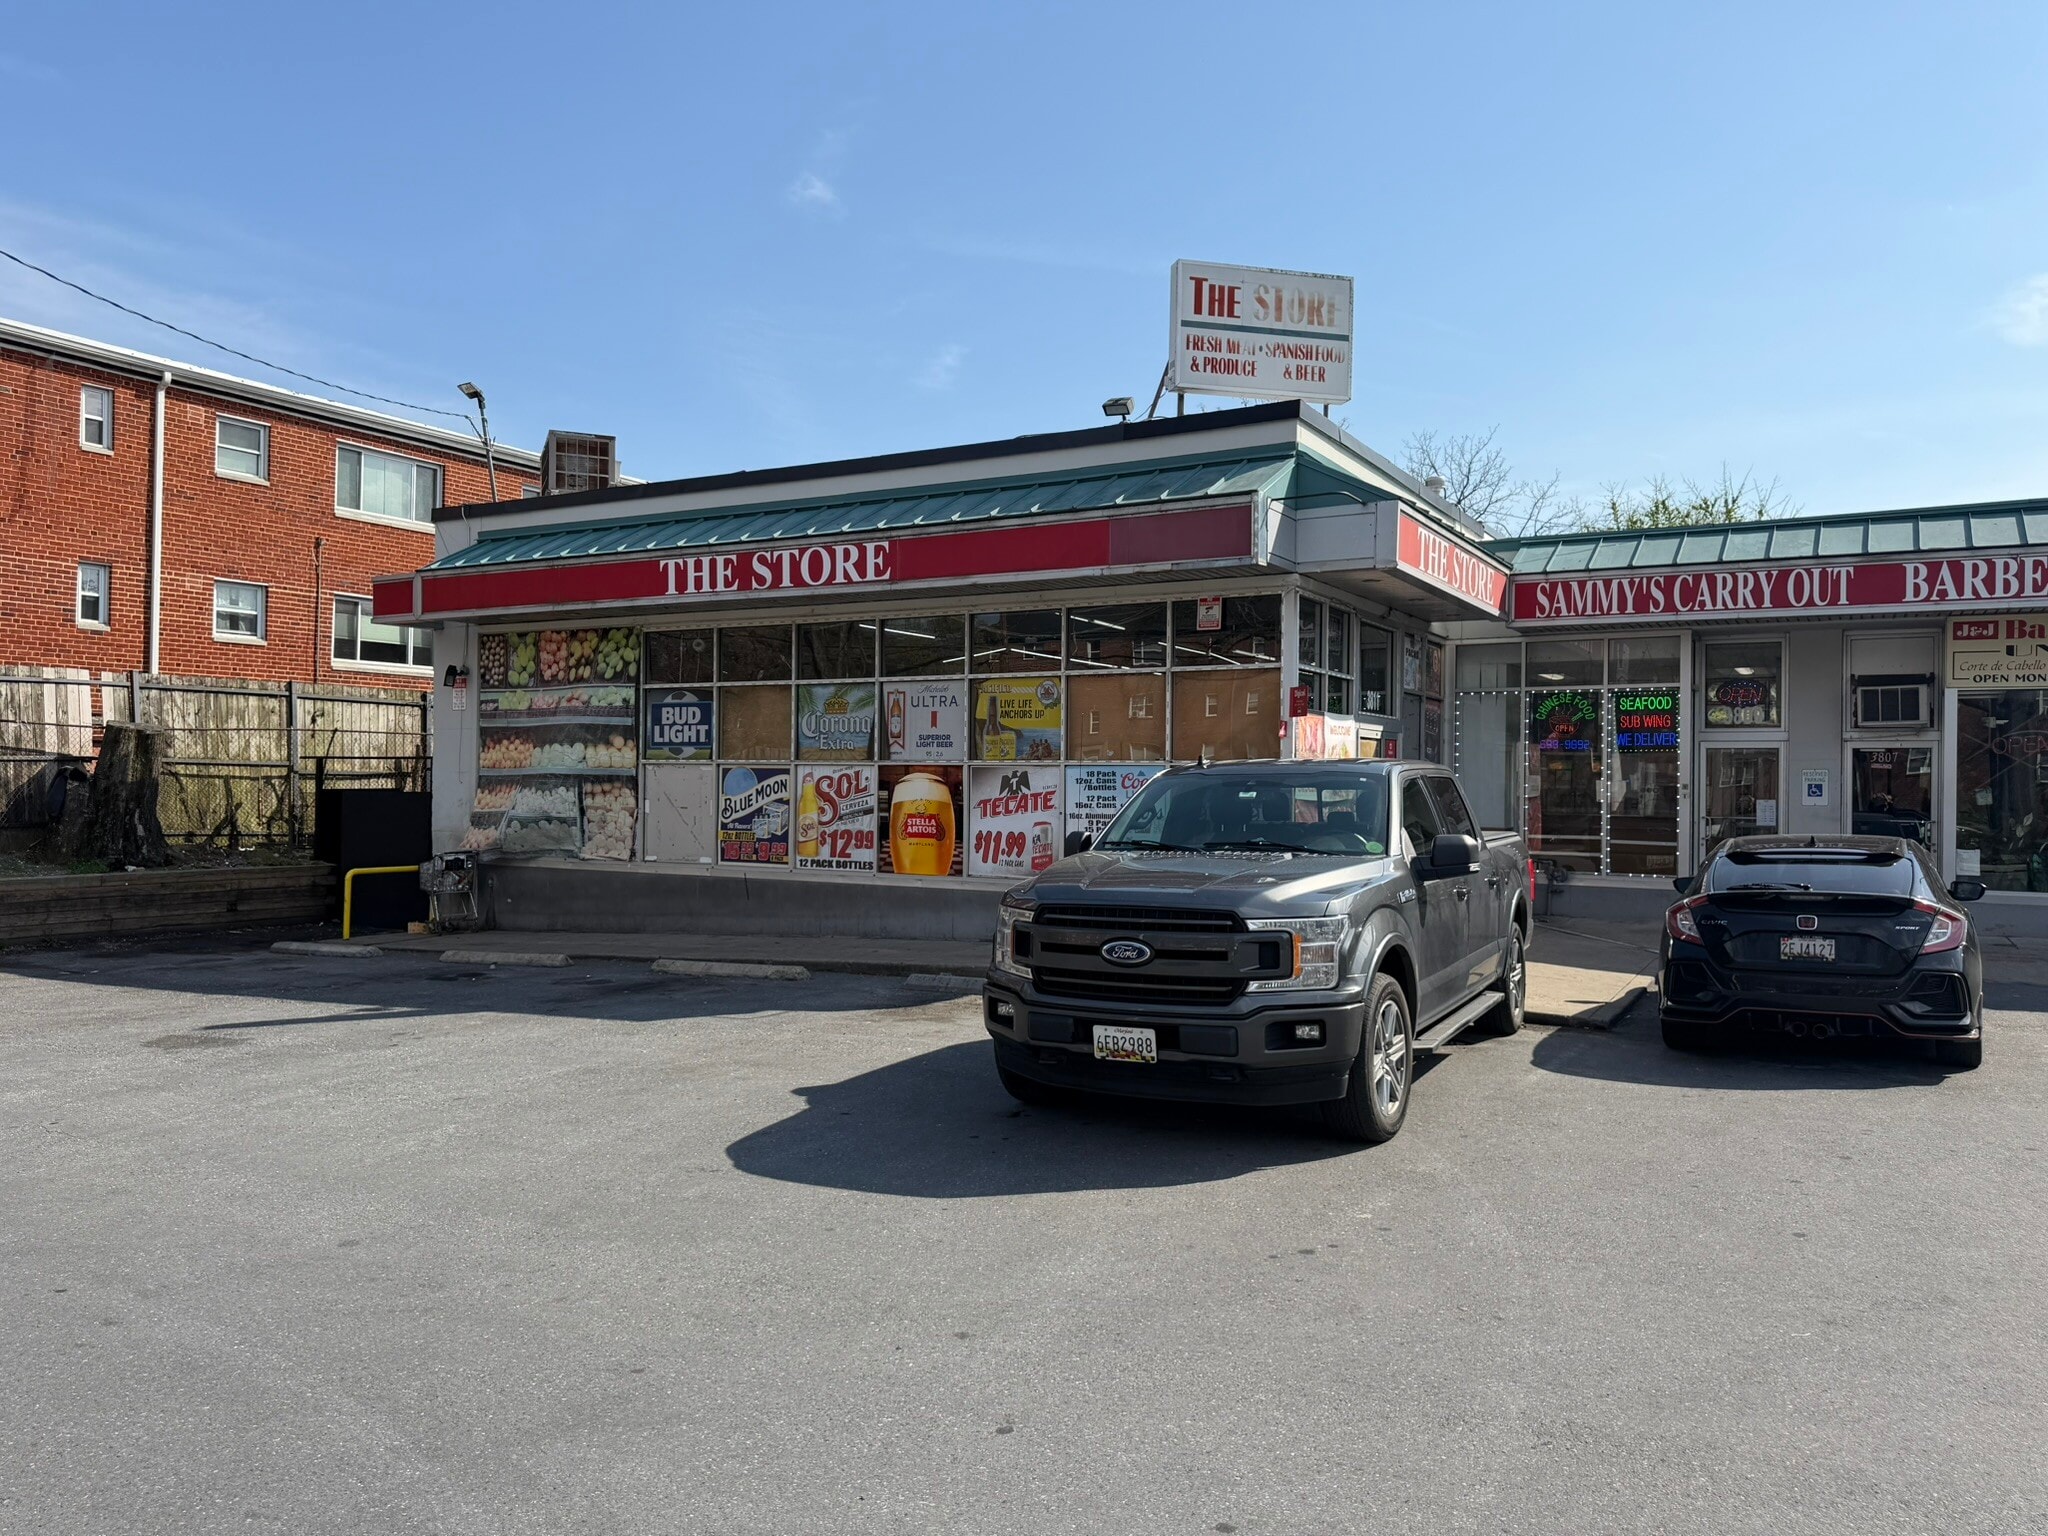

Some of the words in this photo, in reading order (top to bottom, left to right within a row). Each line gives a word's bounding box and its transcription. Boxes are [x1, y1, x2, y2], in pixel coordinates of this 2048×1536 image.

[1189, 276, 1242, 319] THE
[1186, 334, 1222, 353] FRESH
[1265, 341, 1313, 361] SPANISH
[1315, 346, 1345, 364] FOOD
[1190, 356, 1200, 372] &
[1203, 359, 1257, 377] PRODUCE
[1283, 364, 1292, 380] &
[1296, 364, 1326, 383] BEER
[659, 554, 738, 595] THE
[751, 541, 891, 590] STORE
[1417, 526, 1449, 582] THE
[1452, 548, 1495, 605] STORE
[1902, 556, 2048, 601] BARBE
[1535, 575, 1665, 619] SAMMY'S
[1673, 570, 1779, 611] CARRY
[1787, 566, 1854, 606] OUT
[1956, 623, 1994, 637] J&J
[1960, 661, 1988, 672] Corte
[1991, 660, 2003, 671] de
[2006, 659, 2046, 671] Cabello
[1973, 673, 2009, 683] OPEN
[2015, 673, 2047, 682] MON
[911, 695, 959, 708] ULTRA
[1720, 687, 1763, 702] OPEN
[1000, 699, 1015, 708] LIVE
[1018, 699, 1033, 708] LIFE
[1536, 693, 1573, 720] CHINESE
[1573, 695, 1596, 720] FOOD
[1620, 697, 1672, 711] SEAFOOD
[662, 706, 701, 725] BUD
[1000, 709, 1033, 718] ANCHORS
[1035, 709, 1045, 718] UP
[801, 710, 871, 740] Corona
[1555, 724, 1574, 732] OPEN
[1620, 716, 1640, 728] SUB
[1643, 715, 1671, 727] WING
[654, 725, 708, 742] LIGHT
[1617, 733, 1633, 746] WE
[1634, 732, 1676, 746] DELIVER
[820, 735, 854, 750] Extra
[1870, 752, 1898, 762] 3807
[721, 793, 753, 820] BLUE
[755, 779, 788, 804] MOON
[815, 770, 868, 828] SOL
[841, 799, 869, 811] CERVEZA
[974, 790, 1057, 819] TECATE
[735, 832, 756, 840] BOTTLES
[974, 830, 1027, 864] $11.99
[798, 858, 808, 868] 12
[810, 859, 834, 869] PACK
[836, 860, 873, 870] BOTTLES
[1112, 945, 1139, 958] Ford
[1782, 942, 1834, 957] 2EJ4127
[1097, 1035, 1153, 1053] 6EB2988
